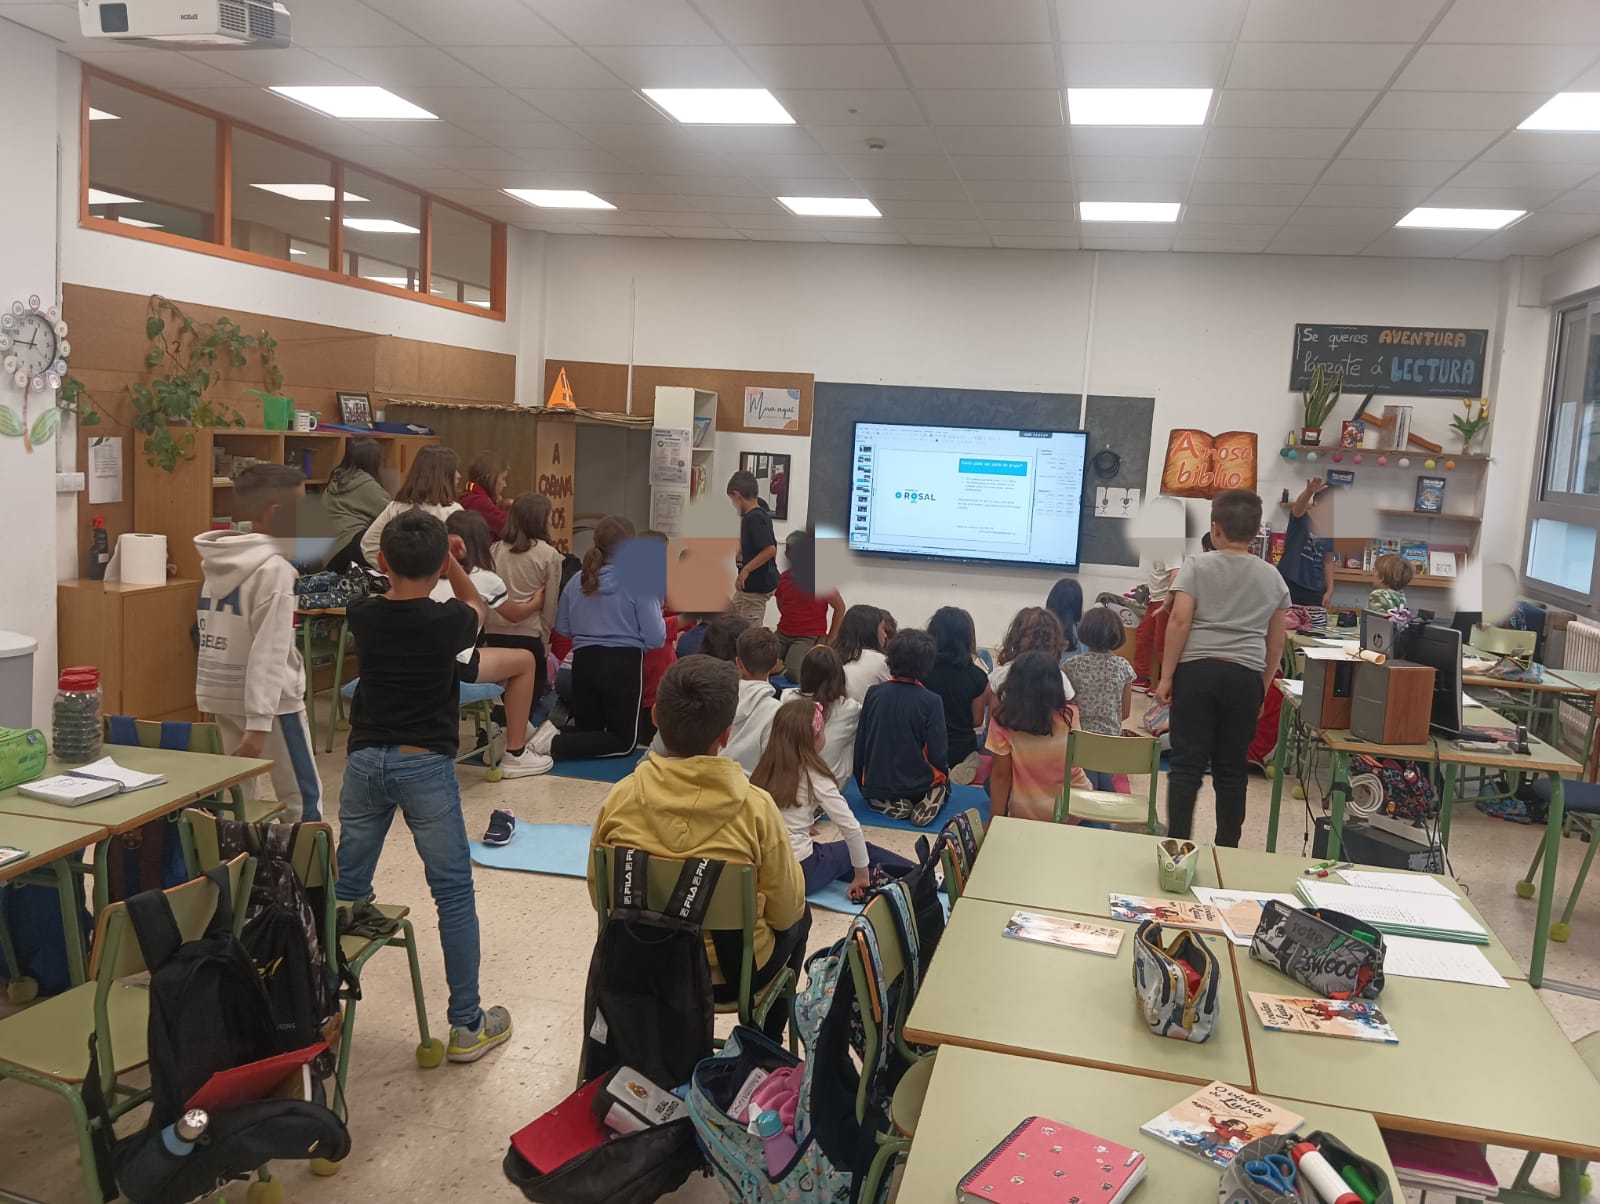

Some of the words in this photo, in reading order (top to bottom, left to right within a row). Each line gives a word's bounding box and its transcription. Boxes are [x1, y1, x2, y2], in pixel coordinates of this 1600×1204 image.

[1302, 327, 1319, 342] Se
[1328, 333, 1369, 351] queres
[1378, 329, 1467, 348] AVENTURA
[1370, 355, 1384, 375] á
[1390, 355, 1475, 385] LECTURA
[552, 442, 560, 465] A
[1169, 431, 1199, 459] A
[1203, 447, 1254, 461] nosa
[1177, 461, 1243, 489] biblio
[904, 491, 937, 502] ROSAL
[551, 506, 566, 530] OS
[199, 633, 228, 651] GELES
[624, 871, 633, 895] FILA
[684, 886, 698, 909] FILA
[655, 1101, 669, 1114] REAL
